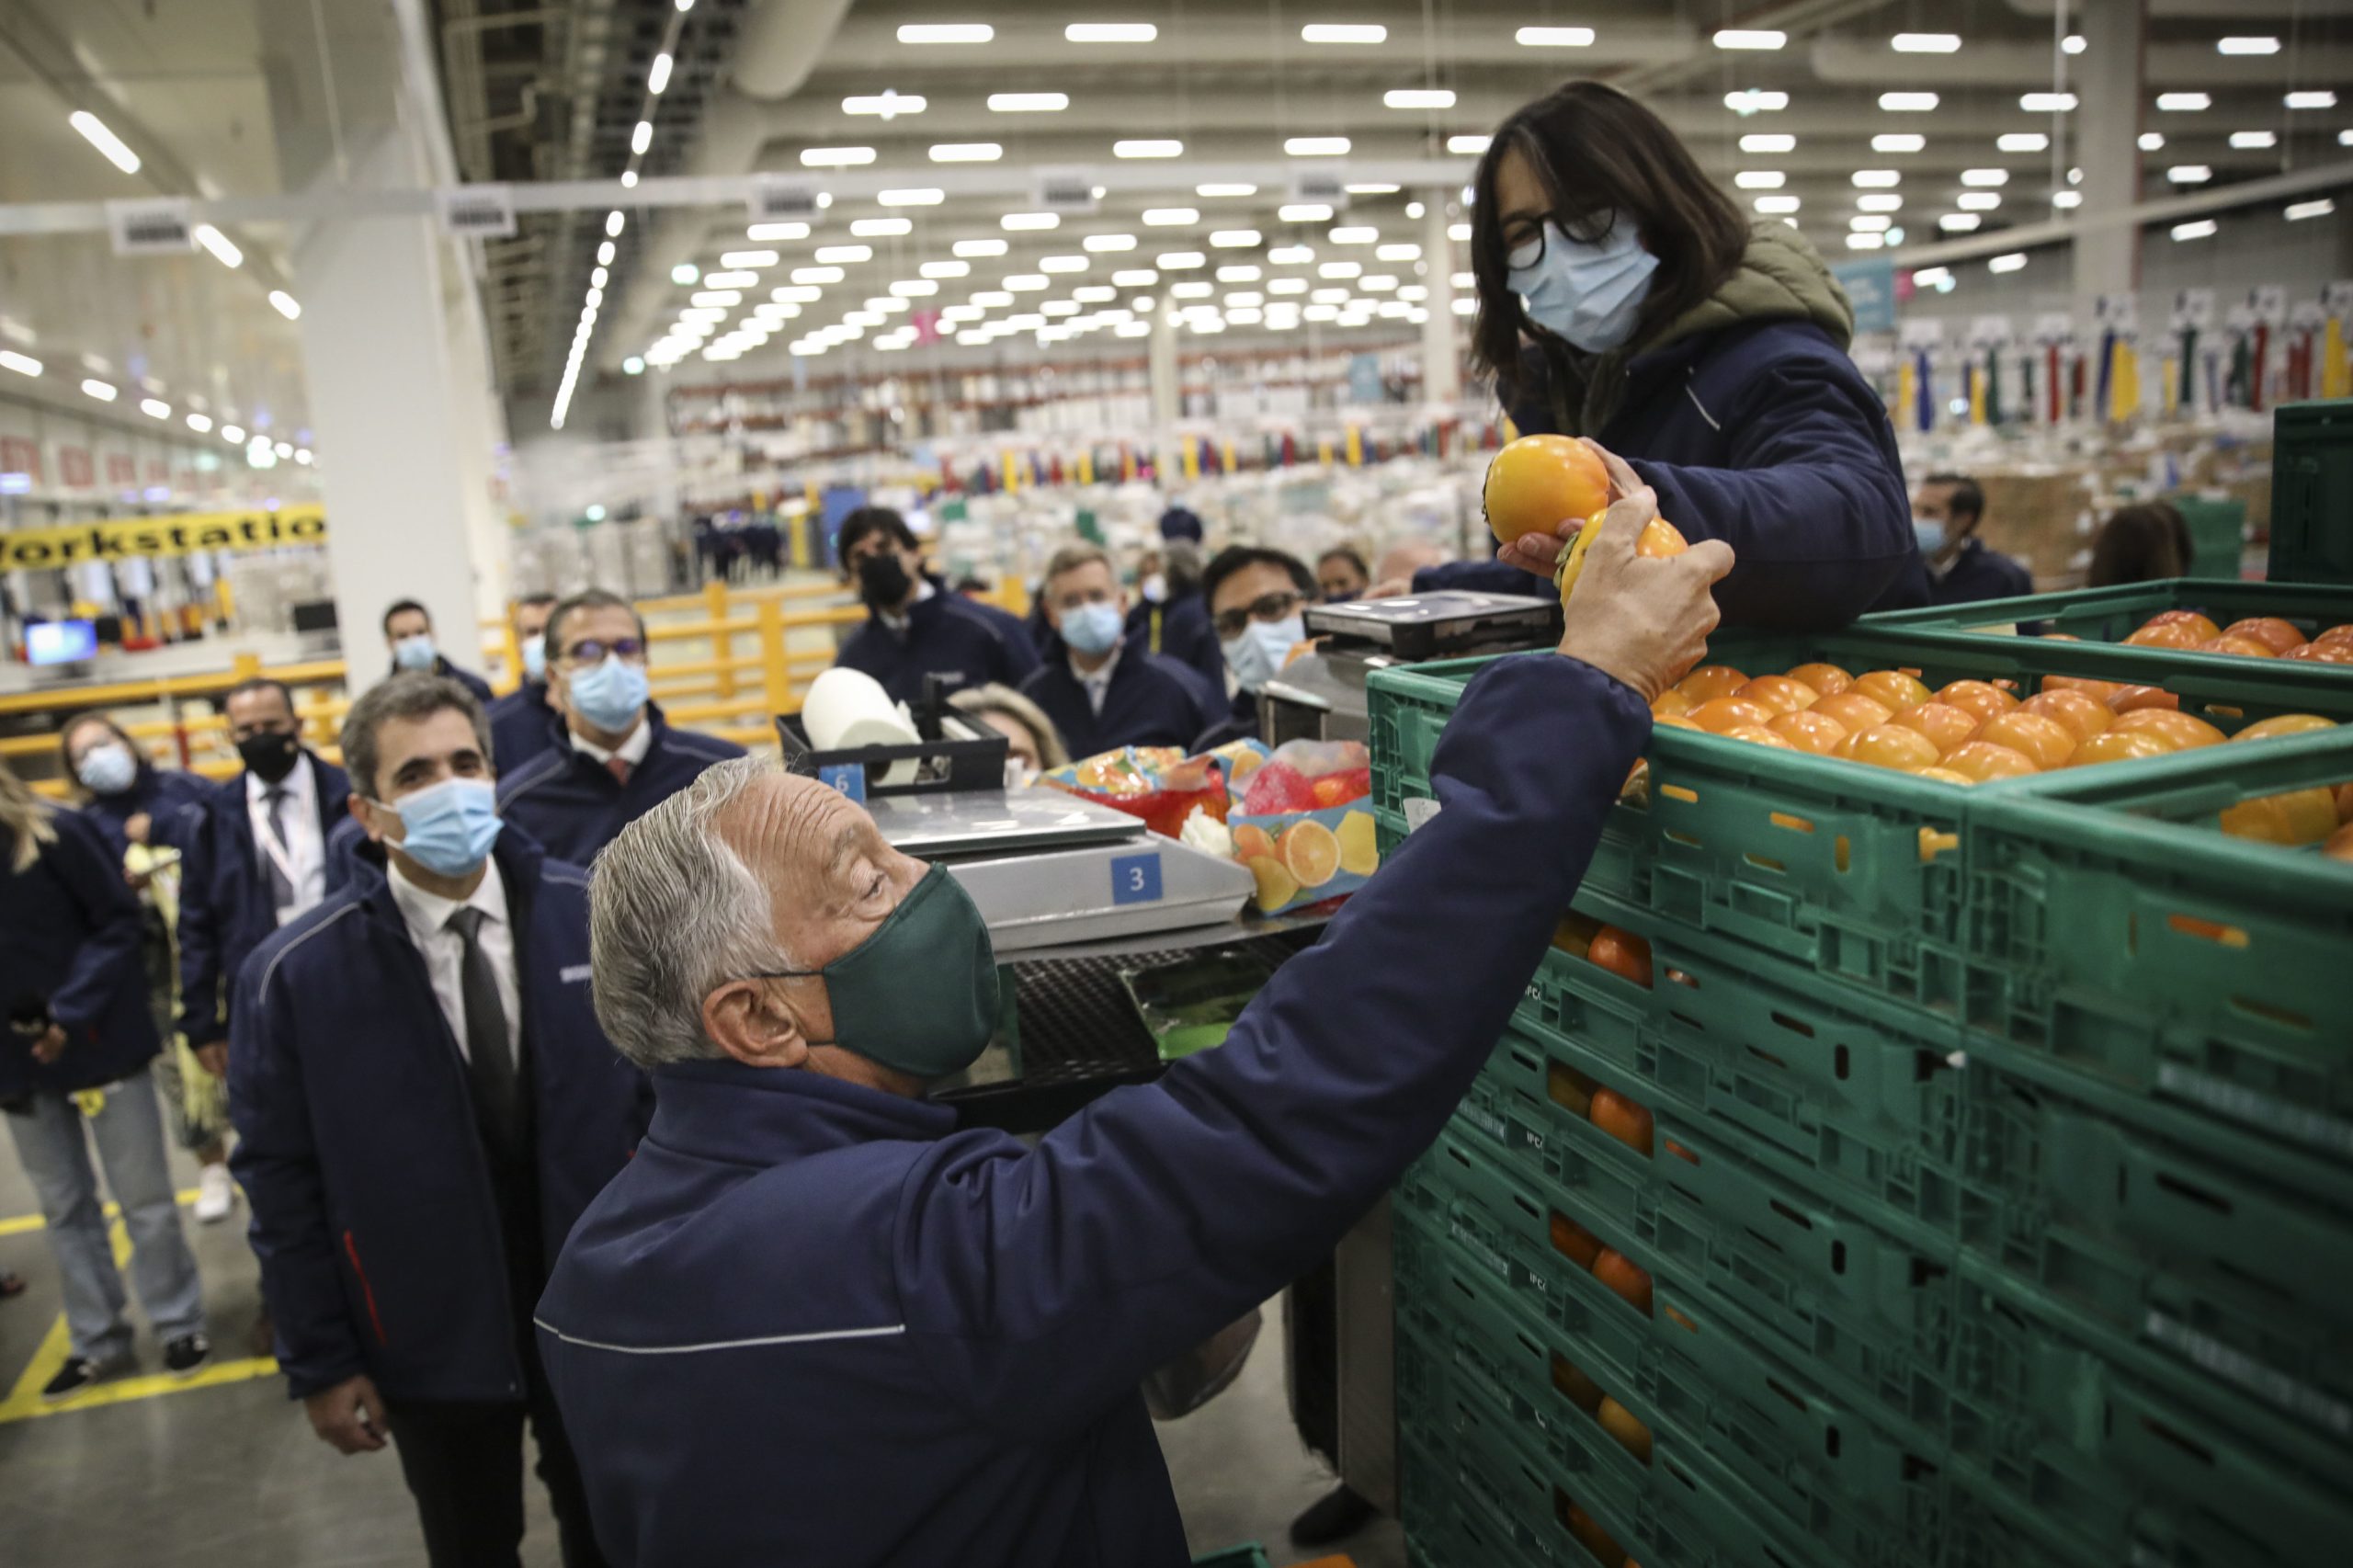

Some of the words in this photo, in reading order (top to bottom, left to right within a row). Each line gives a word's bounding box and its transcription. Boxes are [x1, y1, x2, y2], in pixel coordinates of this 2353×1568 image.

[0, 513, 326, 567] orkstatio
[835, 773, 849, 792] 6
[1130, 867, 1145, 892] 3
